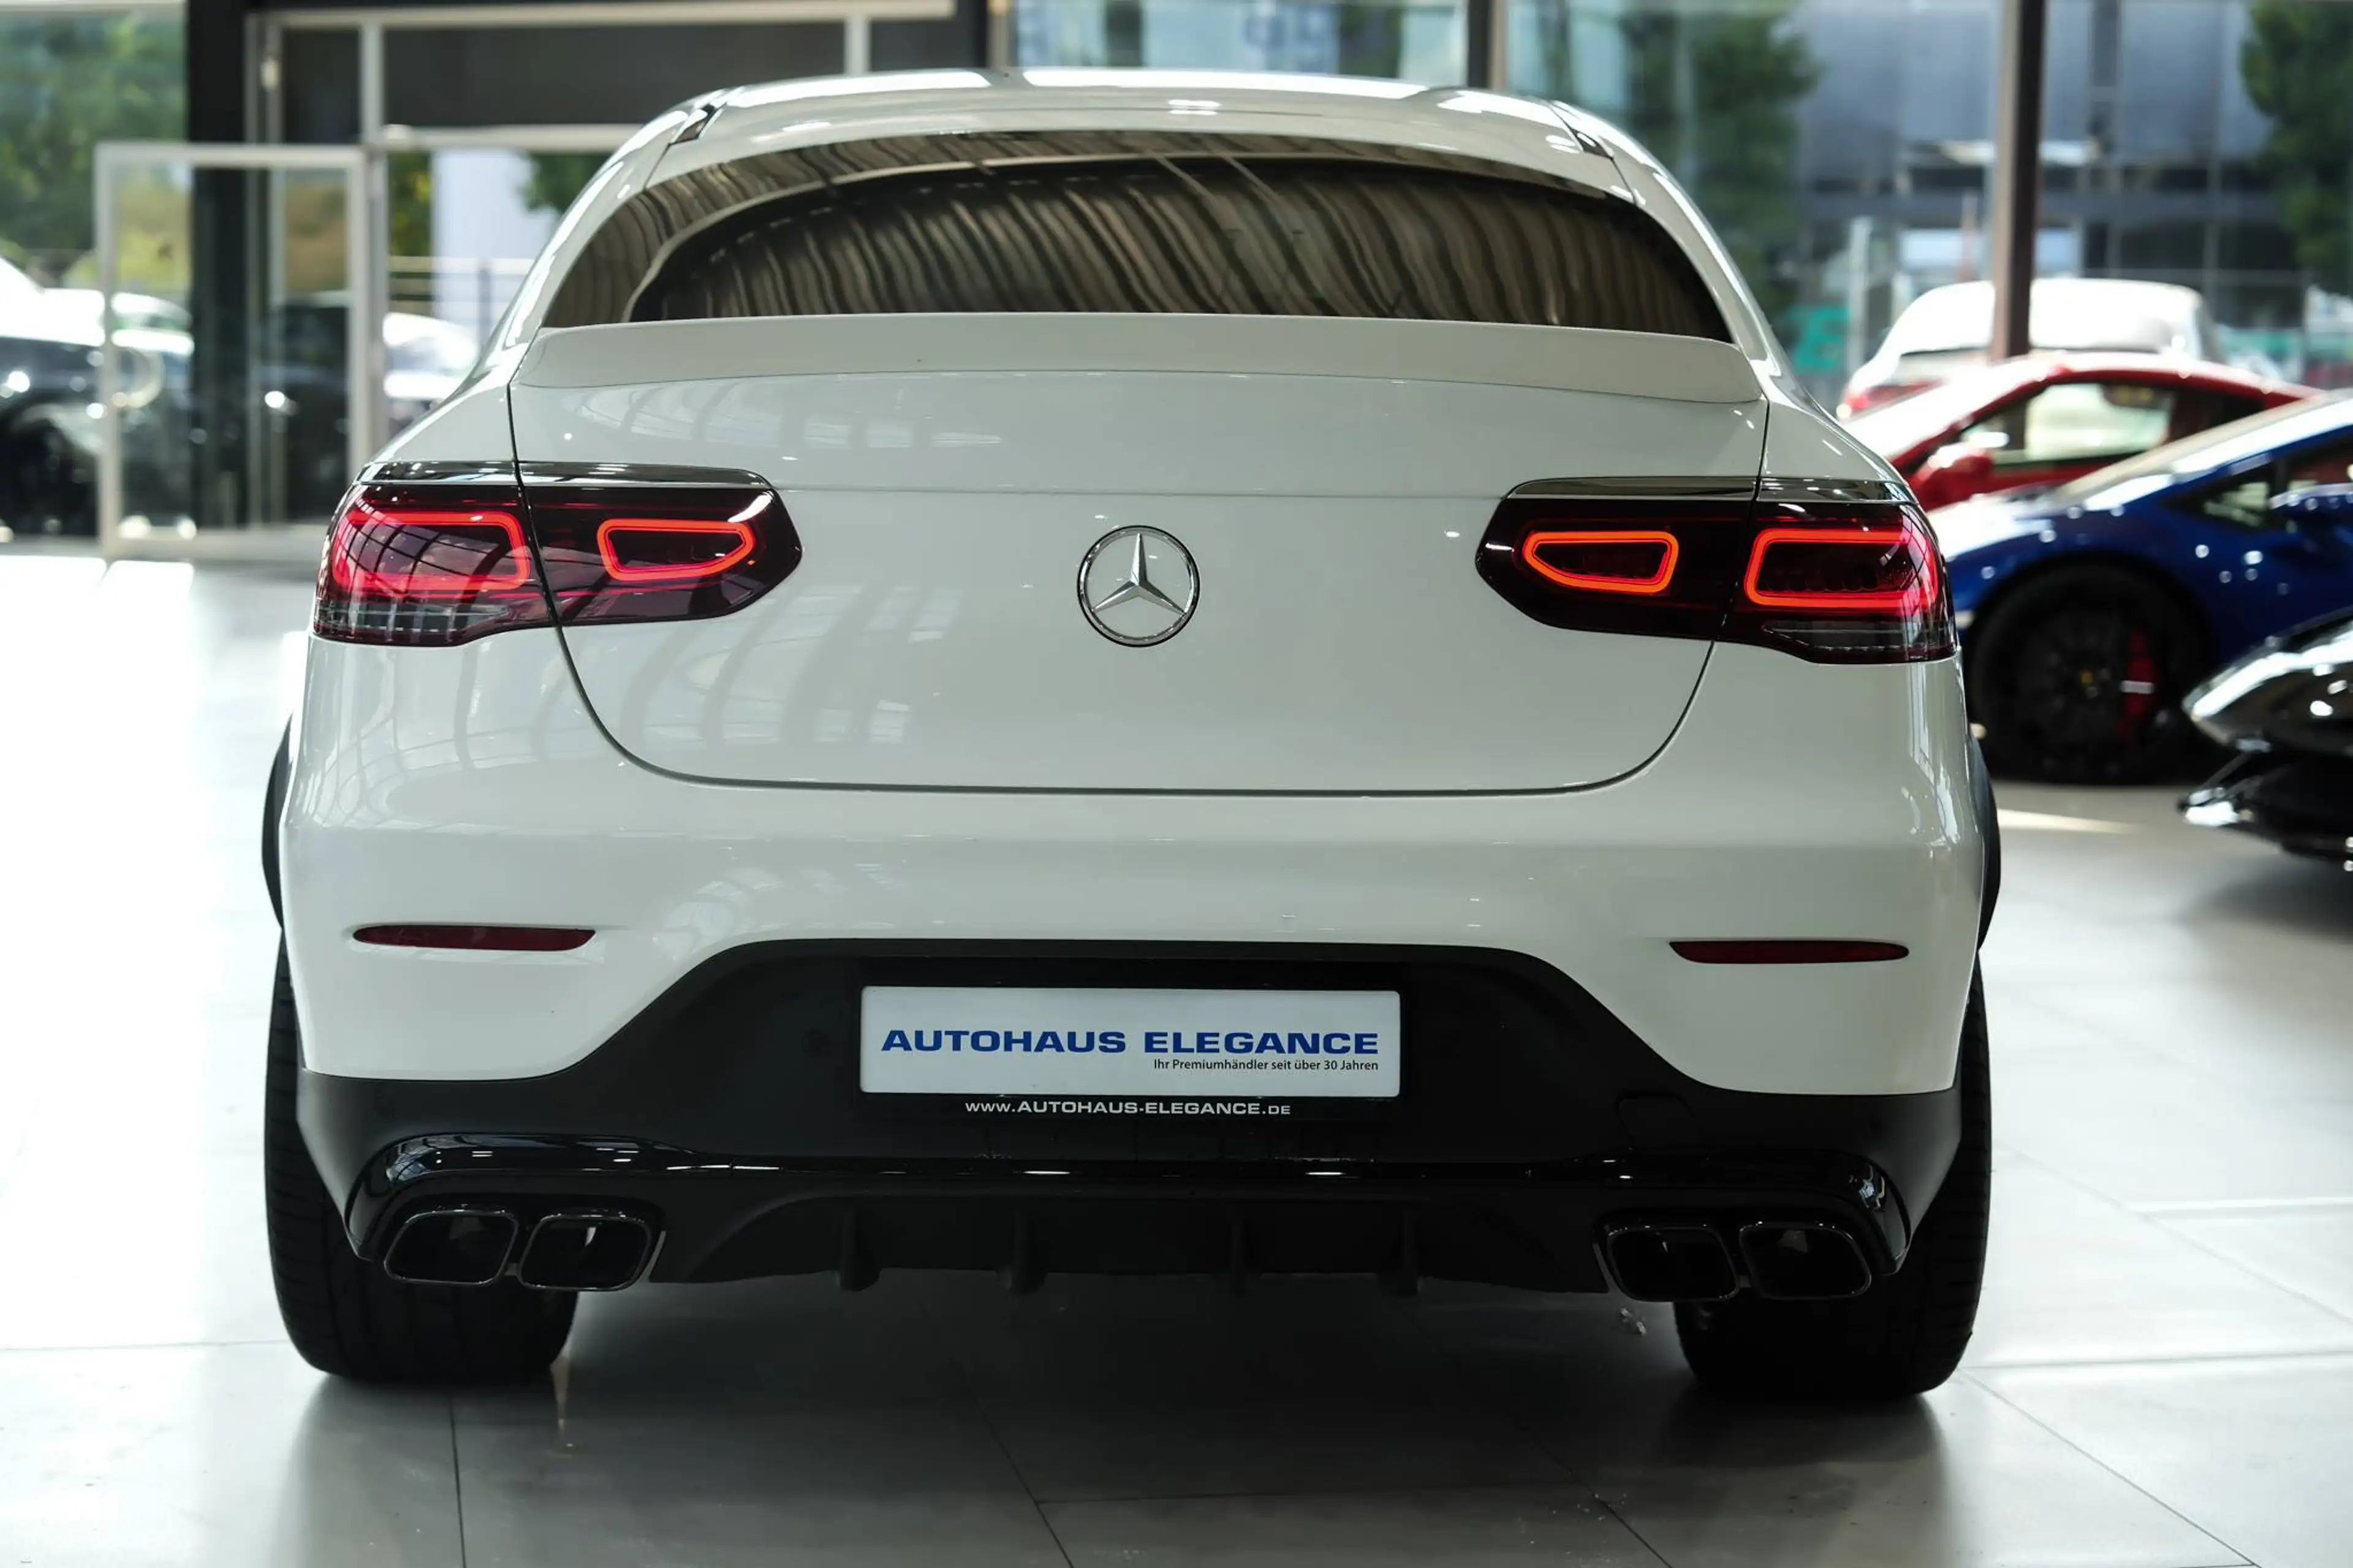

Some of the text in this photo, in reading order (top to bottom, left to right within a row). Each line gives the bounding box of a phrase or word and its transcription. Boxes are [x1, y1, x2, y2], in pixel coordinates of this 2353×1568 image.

[881, 1029, 1379, 1055] AUTOHAUS ELEGANCE
[1154, 1058, 1379, 1071] Ihr Premiumhändler seit über 30 Jahren
